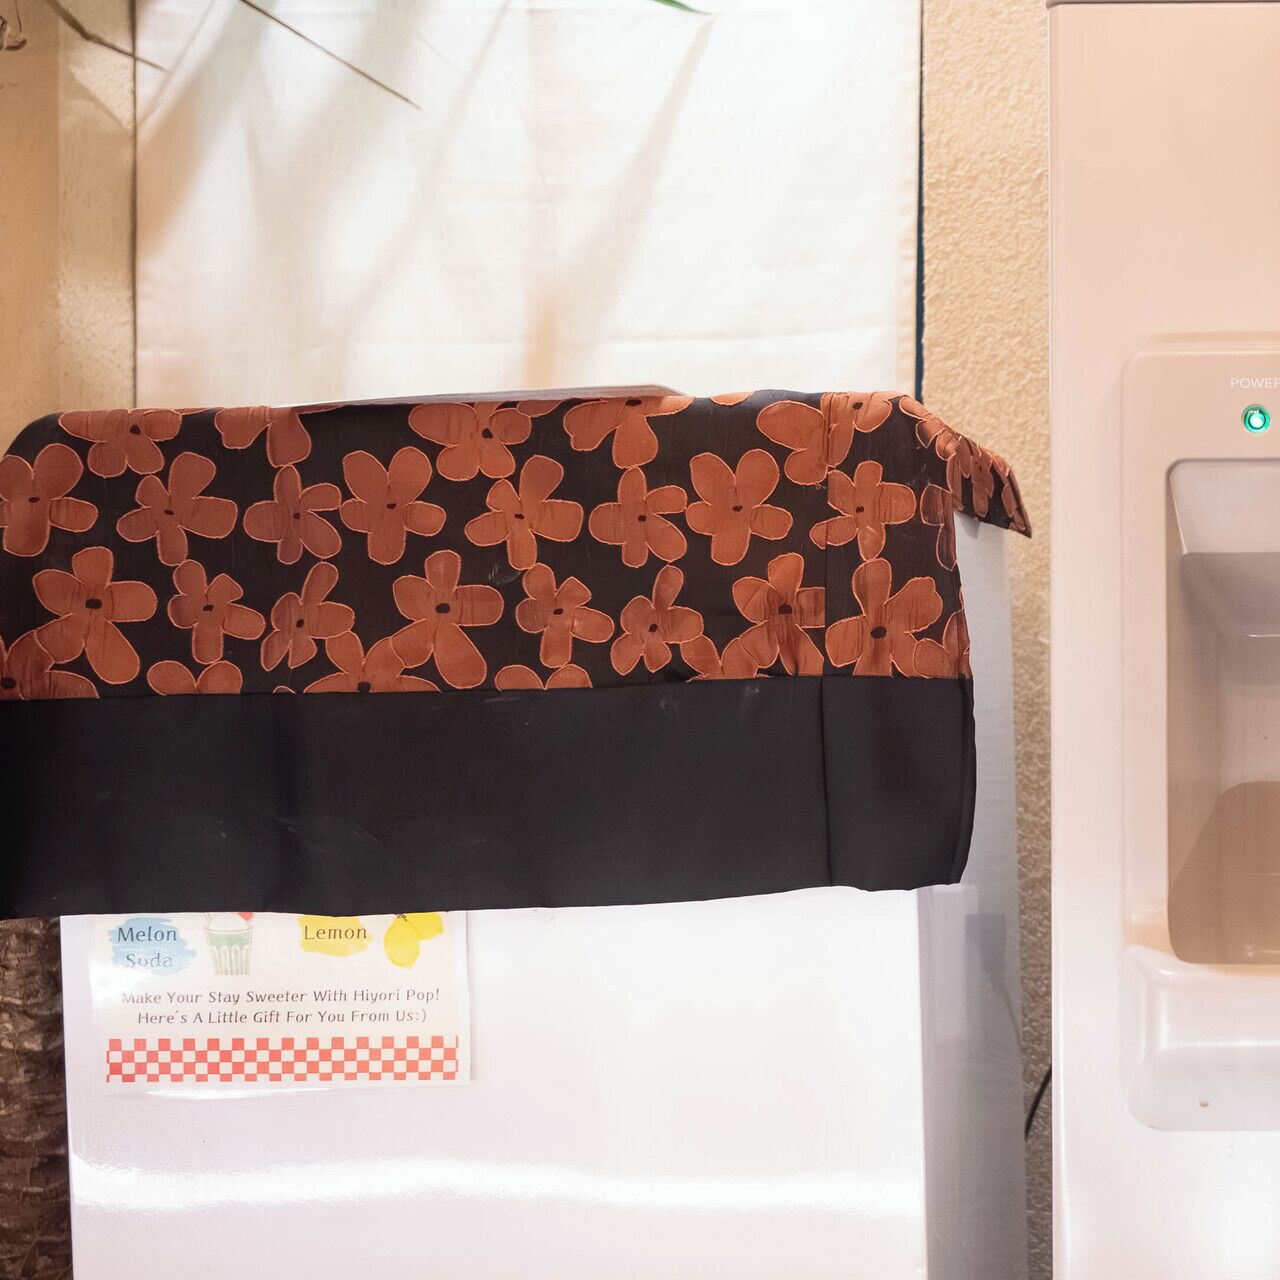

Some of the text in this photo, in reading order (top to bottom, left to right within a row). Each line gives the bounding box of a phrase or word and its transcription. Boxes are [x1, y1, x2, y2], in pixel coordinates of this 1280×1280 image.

[117, 926, 177, 942] Melon
[304, 925, 367, 940] Lemon
[126, 953, 173, 968] Soda
[122, 988, 440, 1005] Make Your Stay Sweeter With Hiyori Pop!
[193, 1012, 207, 1024] A
[209, 1011, 248, 1024] Little
[253, 1010, 281, 1023] Gift
[287, 1010, 313, 1023] For
[318, 1010, 345, 1023] You
[352, 1009, 390, 1022] From
[396, 1008, 427, 1022] Us:)
